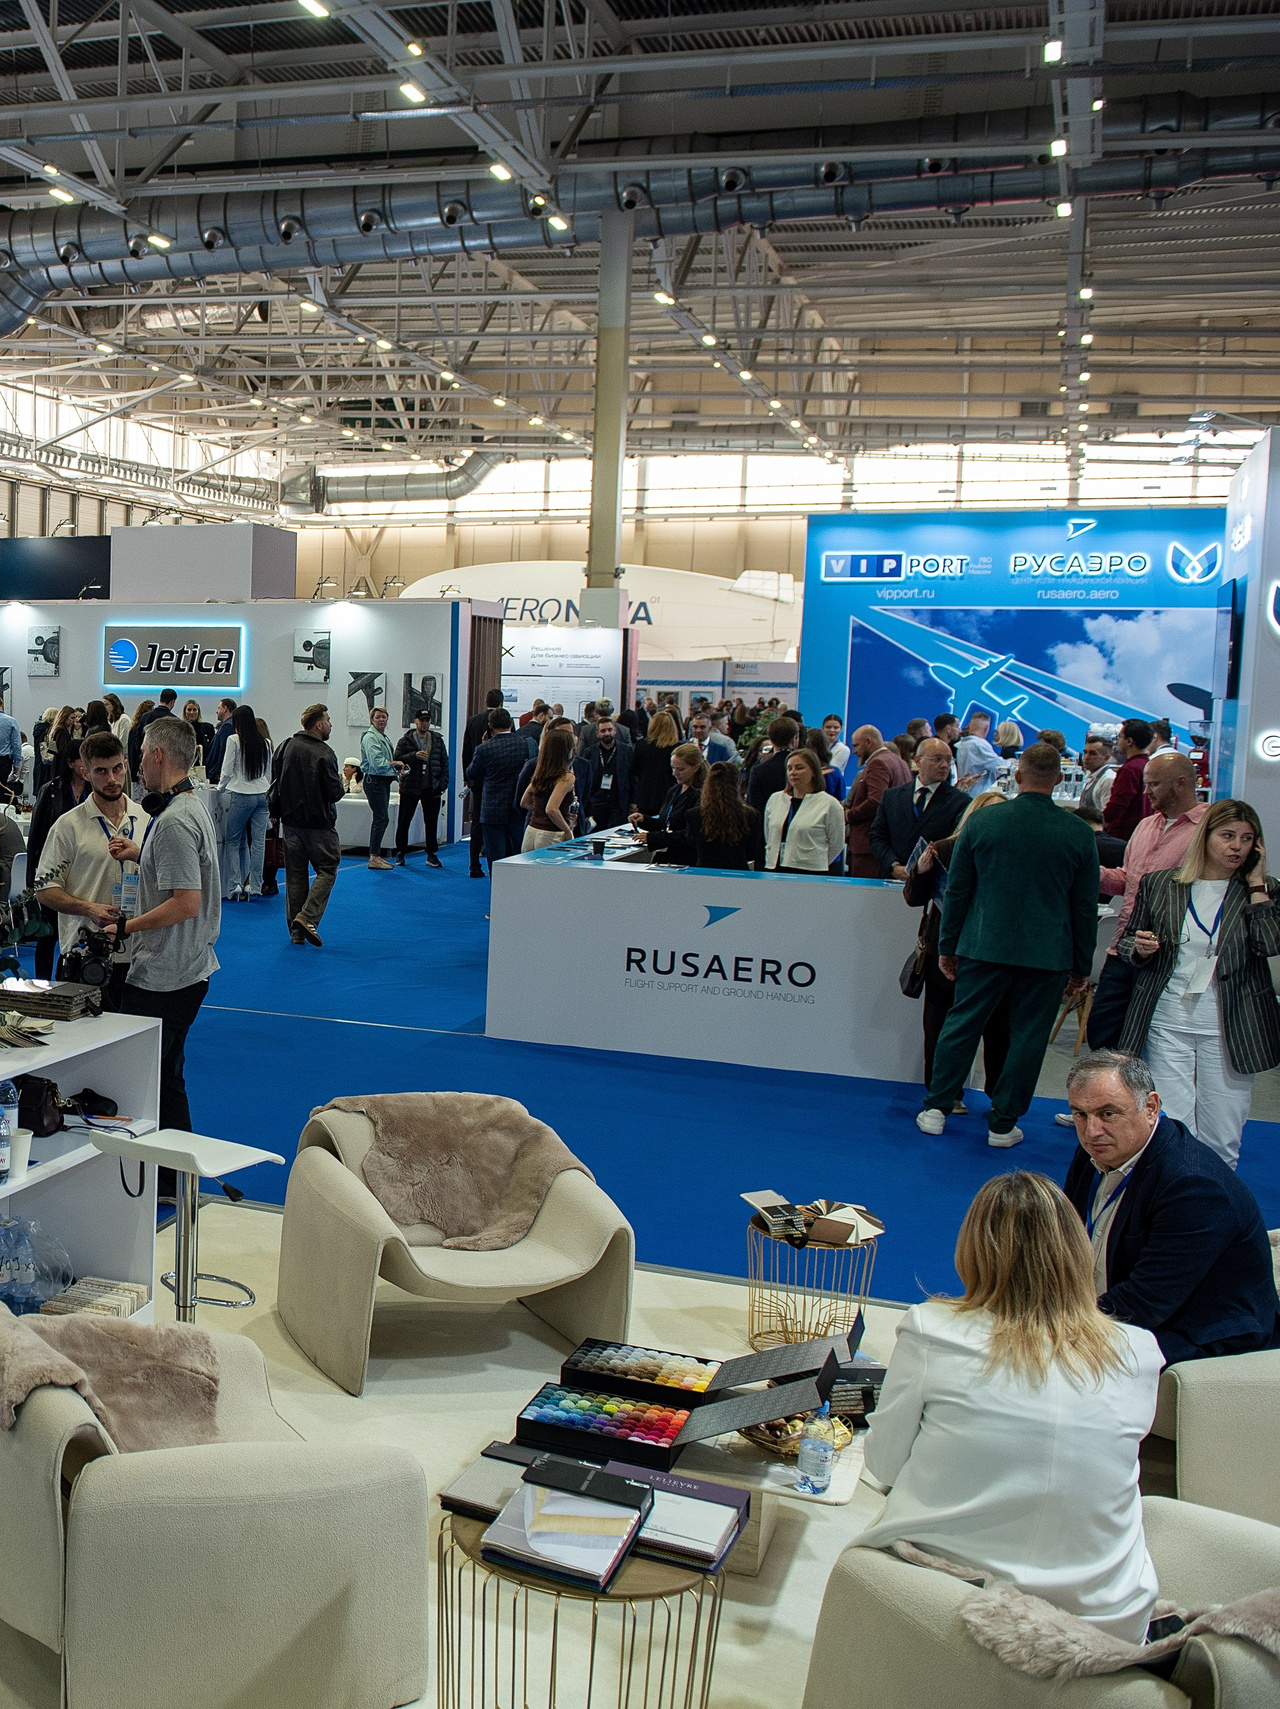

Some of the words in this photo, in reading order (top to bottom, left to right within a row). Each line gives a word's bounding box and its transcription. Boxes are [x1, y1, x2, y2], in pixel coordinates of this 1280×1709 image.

[1012, 555, 1147, 573] РУСАЭРО
[876, 587, 935, 600] vipport.ru
[1037, 589, 1119, 600] rusaero.aero
[139, 642, 236, 675] Jetica
[625, 947, 817, 988] RUSAERO
[624, 978, 655, 990] FLIGHT
[656, 981, 699, 994] SUPPORT
[700, 986, 720, 996] AND
[722, 987, 764, 1000] GROUND
[766, 991, 815, 1005] HANDLING
